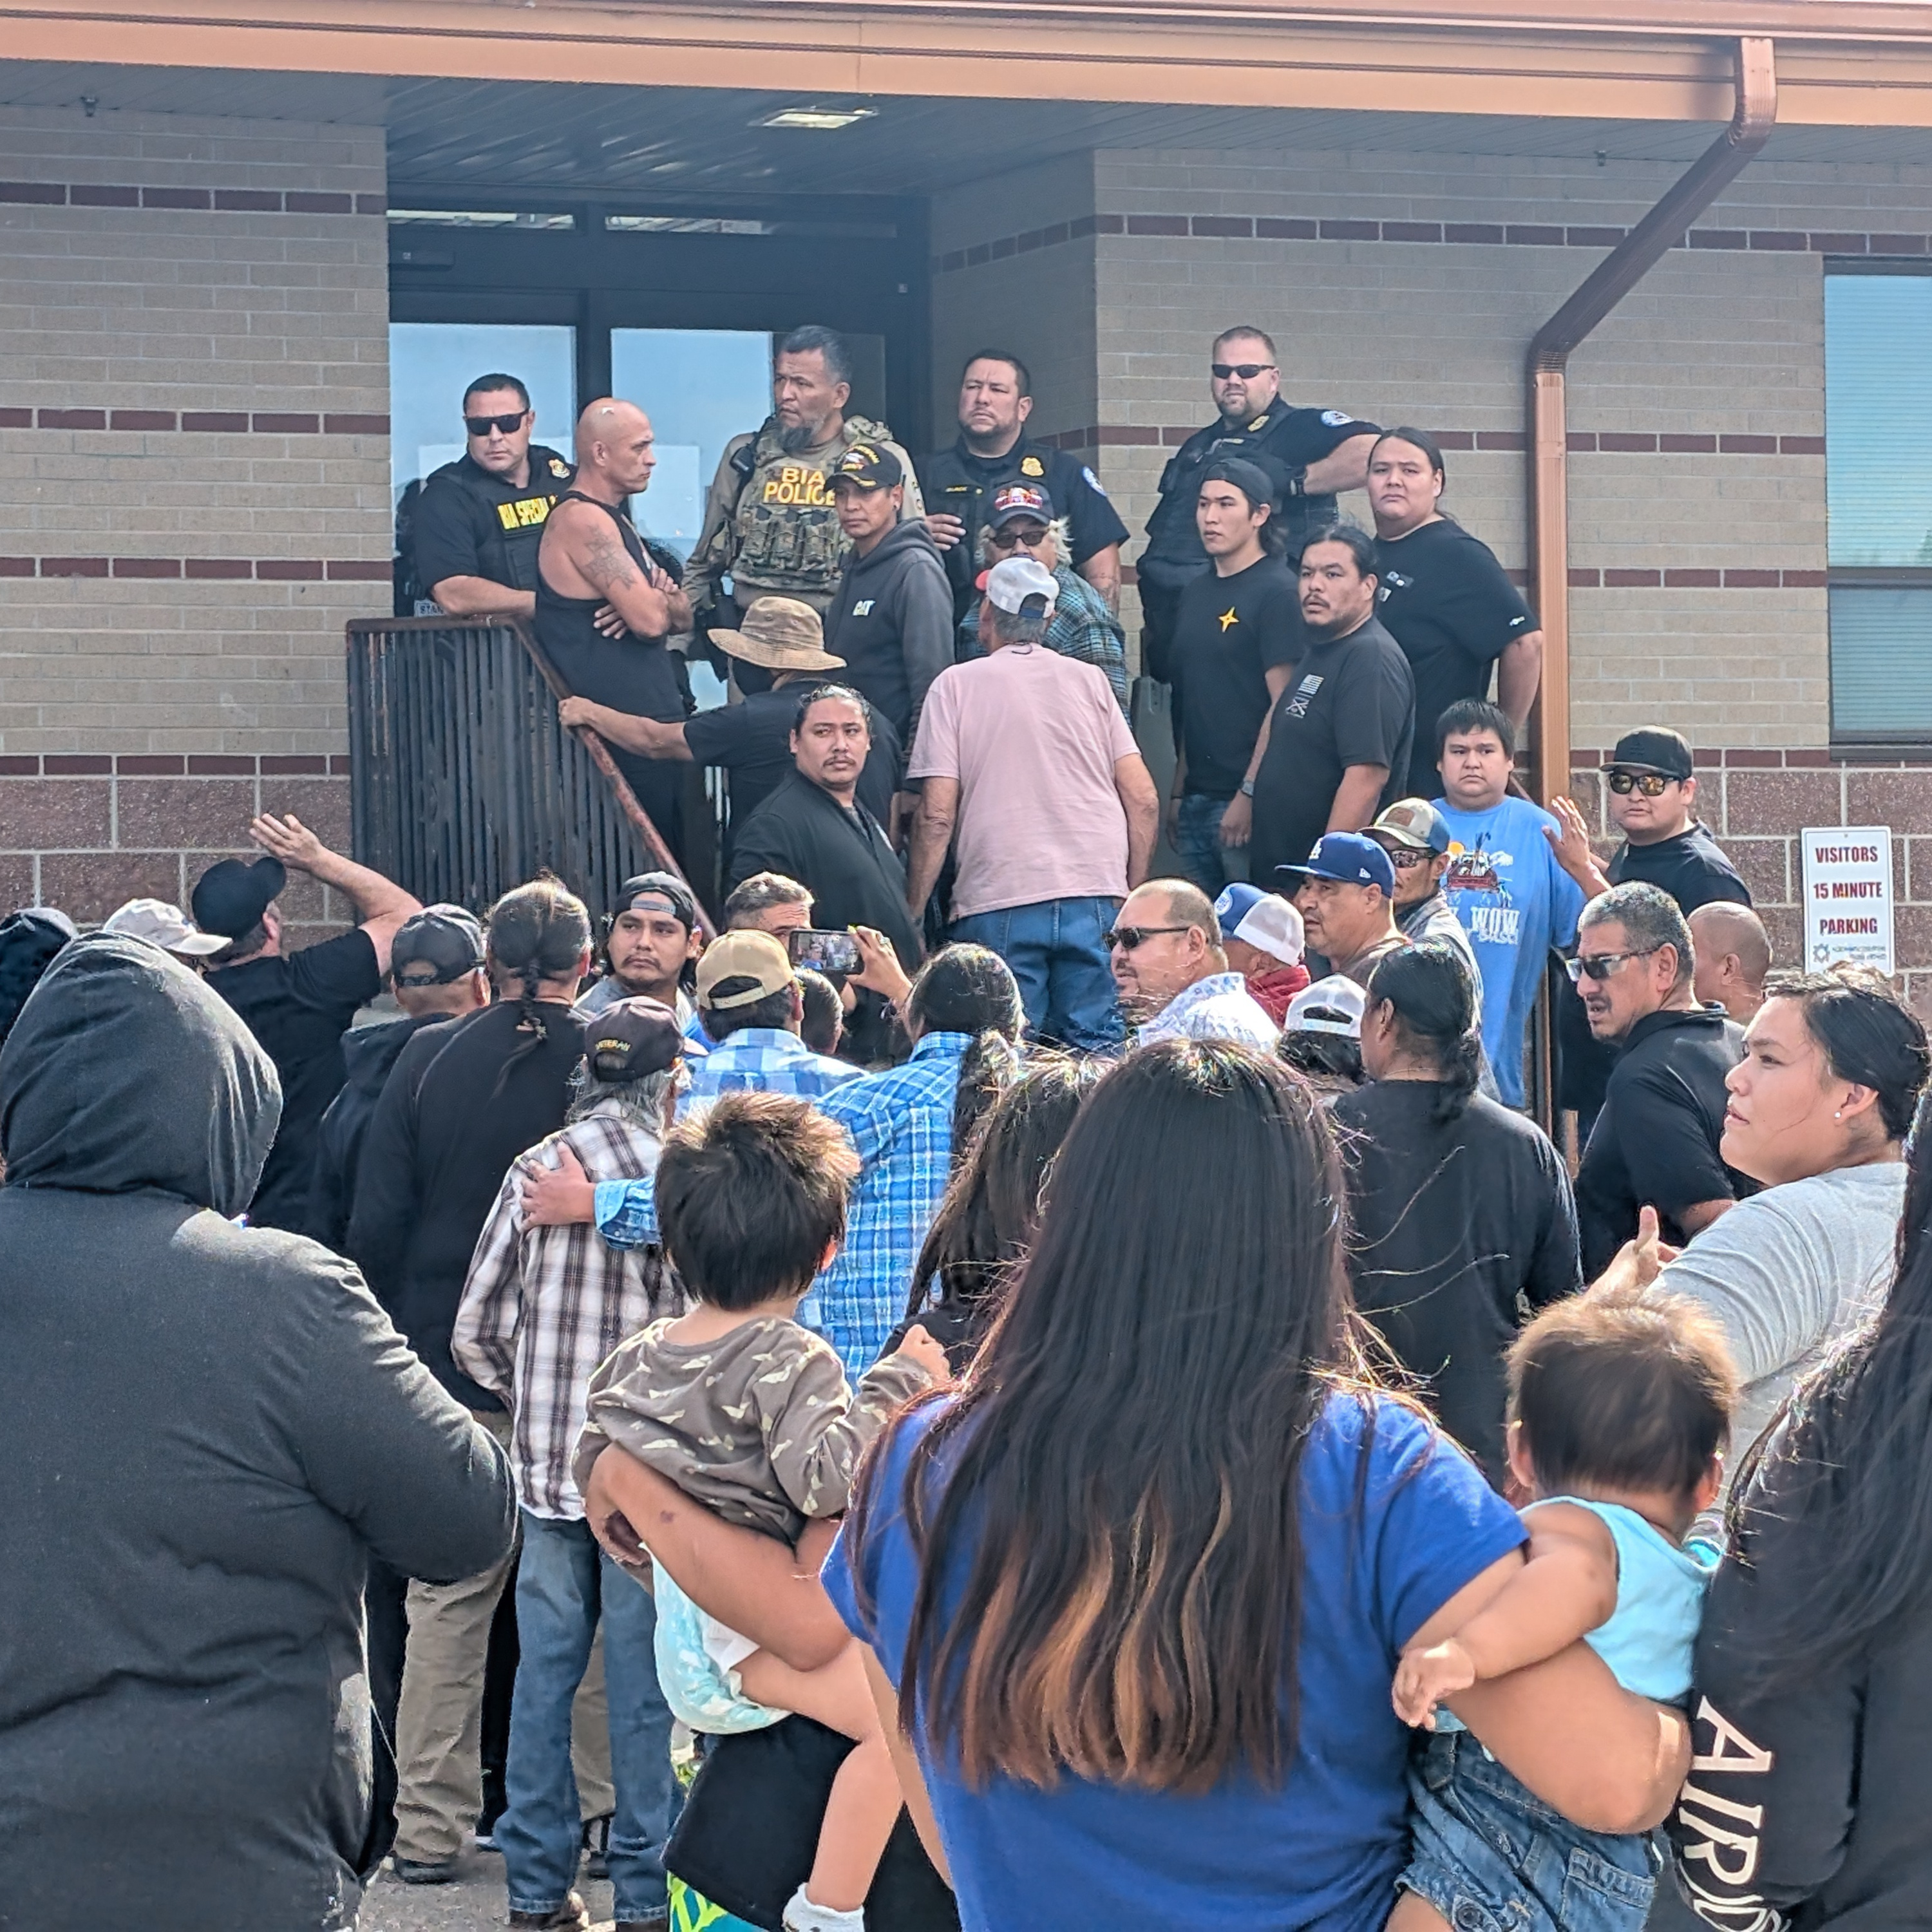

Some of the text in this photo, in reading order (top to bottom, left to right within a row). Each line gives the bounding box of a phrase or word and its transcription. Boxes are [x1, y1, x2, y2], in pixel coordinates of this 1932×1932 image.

[782, 468, 825, 485] BIA
[763, 481, 836, 506] POLICE
[853, 600, 875, 616] CAT
[1815, 846, 1878, 863] VISITORS
[1814, 882, 1882, 899] 15 MINUTE
[1470, 906, 1520, 938] WOW
[1819, 918, 1878, 935] PARKING
[595, 1039, 631, 1052] VETERAN
